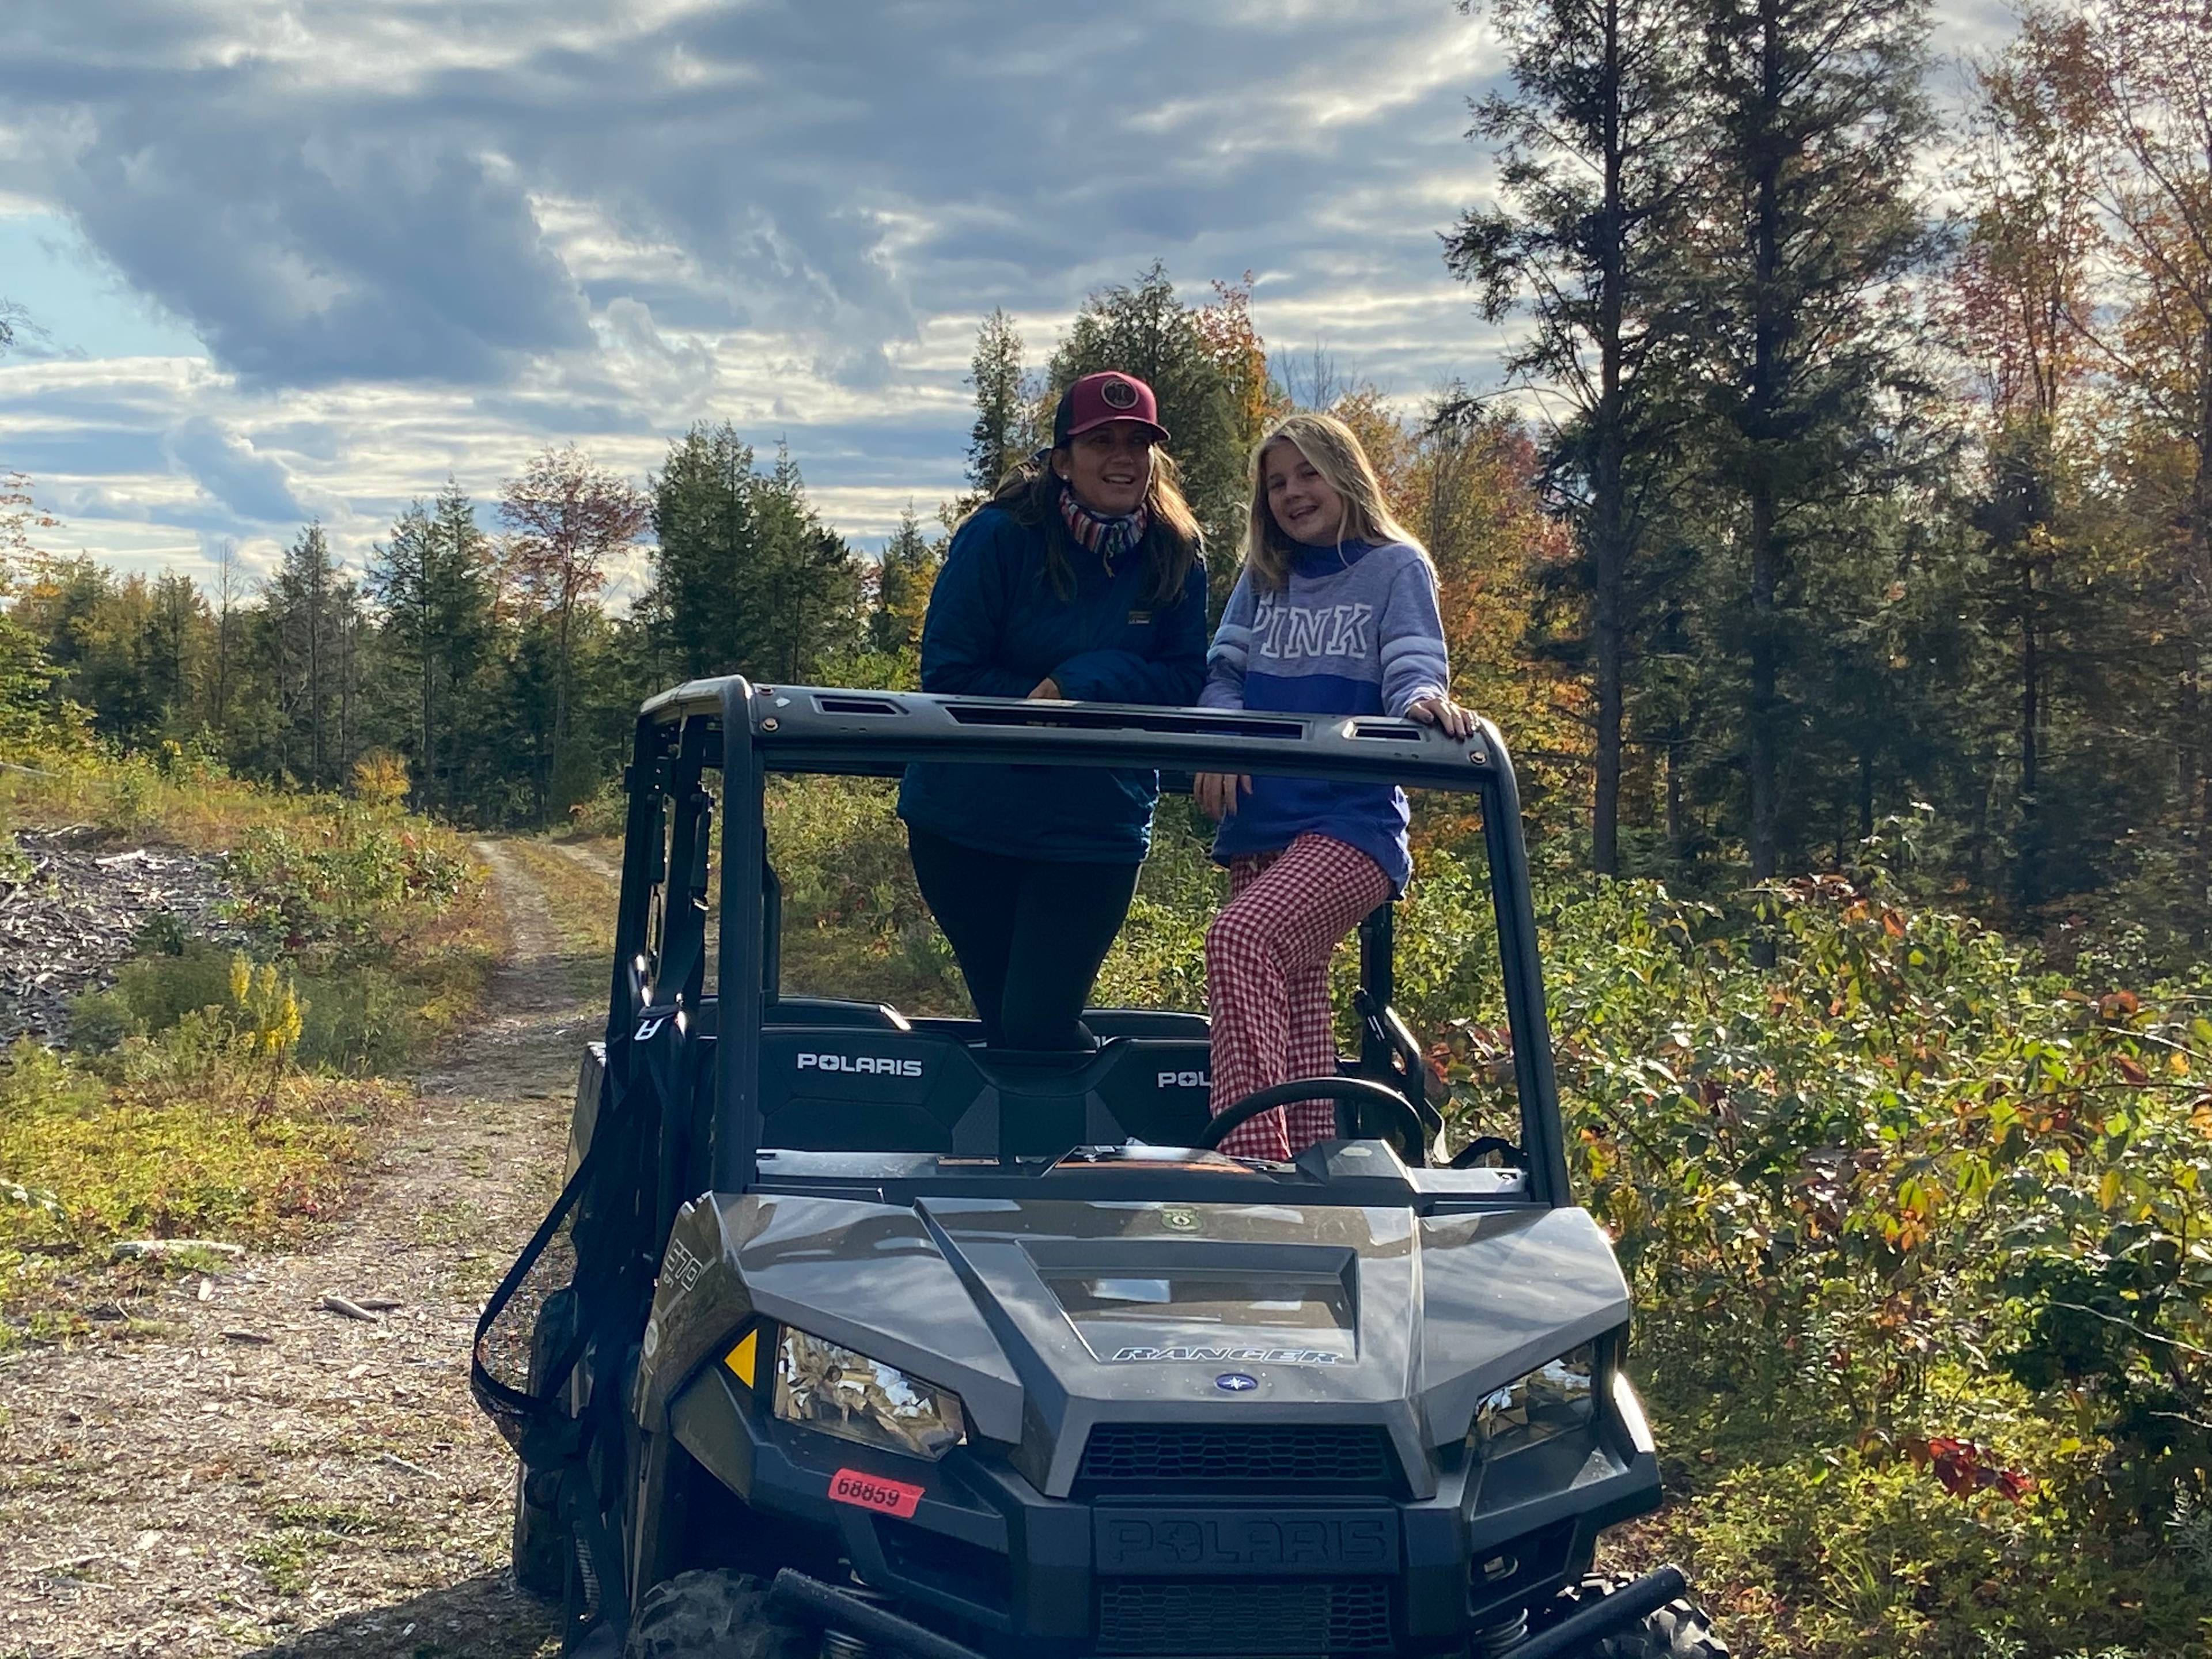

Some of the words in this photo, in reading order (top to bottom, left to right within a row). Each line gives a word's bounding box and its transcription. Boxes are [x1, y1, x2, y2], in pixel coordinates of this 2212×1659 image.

[1252, 597, 1372, 659] PINK
[797, 1053, 922, 1077] POLARIS
[1112, 1346, 1343, 1364] RANGER
[838, 1478, 900, 1507] 68859
[1109, 1520, 1386, 1563] POLARIS
